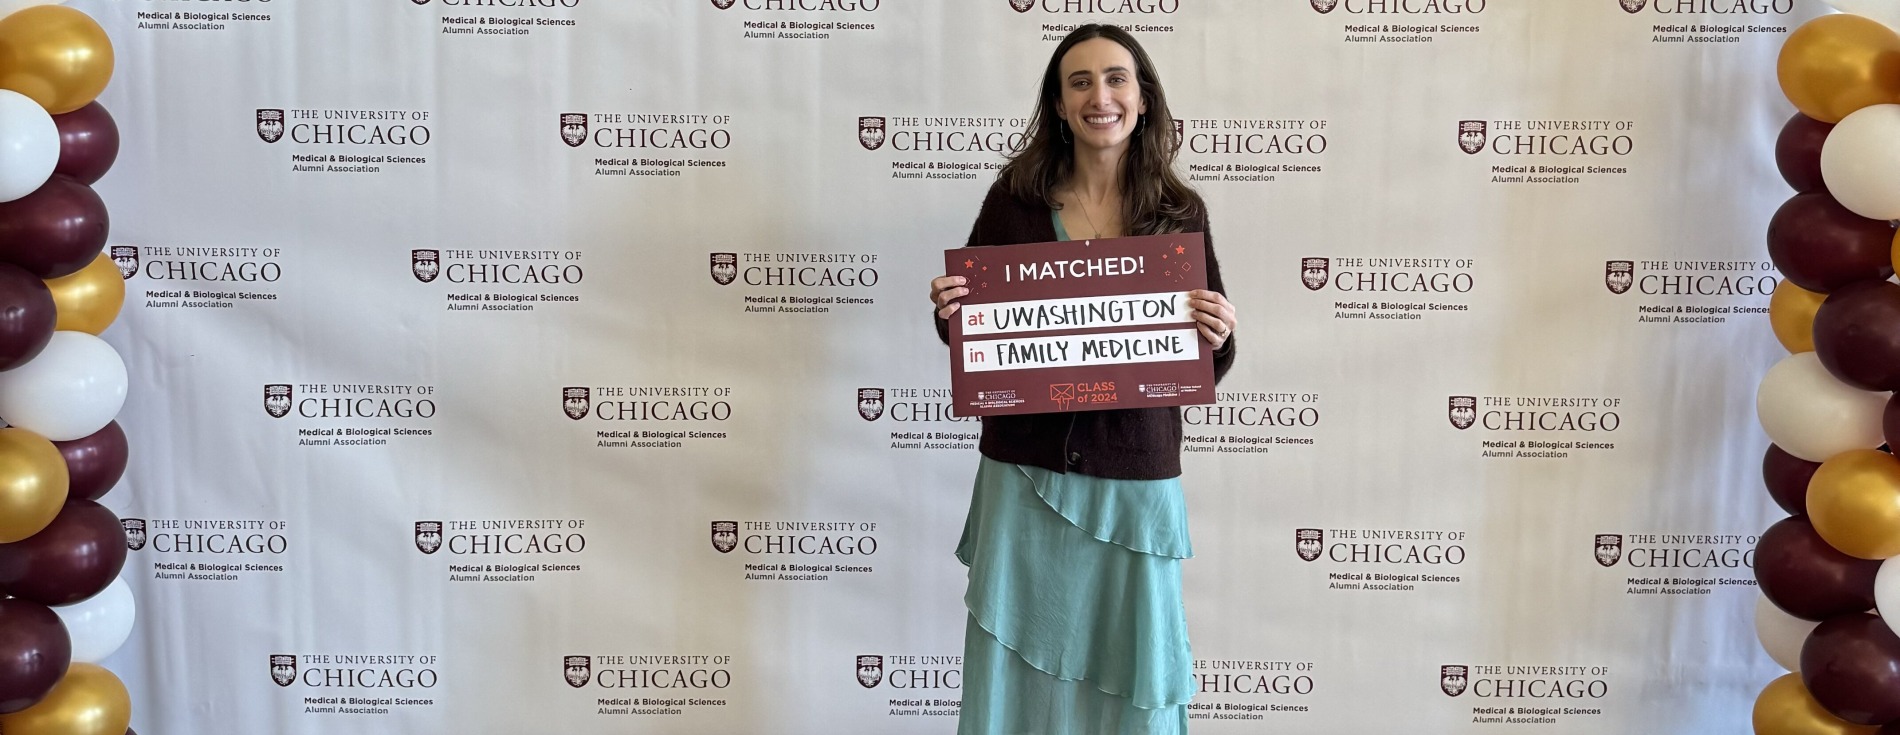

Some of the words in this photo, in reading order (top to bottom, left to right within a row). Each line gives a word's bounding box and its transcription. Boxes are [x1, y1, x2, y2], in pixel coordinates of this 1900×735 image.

[137, 11, 173, 21] Medical
[174, 11, 182, 20] &
[183, 12, 230, 22] Biological
[231, 12, 272, 21] Sciences
[137, 21, 170, 30] Alumni
[171, 21, 225, 31] Association
[743, 20, 779, 30] Medical
[780, 21, 787, 29] &
[788, 21, 834, 31] Biological
[835, 21, 876, 30] Sciences
[1344, 24, 1381, 33] Medical
[1382, 24, 1389, 33] &
[1391, 24, 1438, 34] Biological
[1440, 24, 1480, 33] Sciences
[743, 30, 776, 39] Alumni
[777, 30, 830, 40] Association
[1344, 34, 1377, 43] Alumni
[1378, 34, 1433, 43] Association
[290, 109, 319, 120] THE
[324, 109, 407, 121] UNIVERSITY
[411, 111, 429, 121] OF
[593, 113, 622, 124] THE
[627, 113, 708, 125] UNIVERSITY
[712, 114, 731, 125] OF
[1493, 120, 1522, 131] THE
[1527, 120, 1611, 131] UNIVERSITY
[1615, 120, 1634, 131] OF
[290, 123, 431, 146] CHICAGO
[593, 127, 731, 150] CHICAGO
[1492, 134, 1633, 156] CHICAGO
[292, 153, 328, 163] Medical
[329, 154, 336, 164] &
[338, 155, 385, 165] Biological
[386, 155, 427, 164] Sciences
[594, 157, 630, 167] Medical
[631, 158, 639, 167] &
[640, 158, 686, 168] Biological
[687, 159, 727, 168] Sciences
[291, 163, 325, 172] Alumni
[326, 163, 380, 173] Association
[594, 167, 627, 176] Alumni
[628, 167, 681, 177] Association
[1491, 165, 1528, 174] Medical
[1529, 165, 1537, 174] &
[1538, 165, 1585, 175] Biological
[1586, 165, 1627, 174] Sciences
[1490, 175, 1524, 183] Alumni
[1525, 175, 1580, 184] Association
[445, 249, 474, 259] THE
[478, 249, 560, 260] UNIVERSITY
[564, 250, 582, 261] OF
[1335, 257, 1364, 268] THE
[1369, 258, 1451, 269] UNIVERSITY
[1455, 258, 1474, 269] OF
[445, 263, 584, 285] CHICAGO
[1005, 264, 1011, 282] I
[1019, 256, 1145, 281] MATCHED!
[1334, 271, 1474, 294] CHICAGO
[446, 293, 483, 303] Medical
[483, 293, 491, 302] &
[492, 293, 538, 303] Biological
[540, 293, 580, 302] Sciences
[446, 302, 479, 311] Alumni
[481, 303, 534, 311] Association
[967, 313, 985, 327] at
[993, 294, 1177, 330] UWASHINGTON
[1334, 301, 1370, 311] Medical
[1371, 301, 1379, 311] &
[1380, 302, 1427, 312] Biological
[1428, 302, 1469, 311] Sciences
[1334, 311, 1367, 319] Alumni
[1368, 310, 1422, 320] Association
[969, 348, 985, 363] in
[996, 341, 1069, 366] FAMILY
[1082, 335, 1184, 362] MEDICINE
[298, 383, 328, 394] THE
[332, 384, 413, 395] UNIVERSITY
[416, 385, 434, 395] OF
[1077, 382, 1115, 393] CLASS
[1077, 394, 1089, 403] of
[1091, 392, 1118, 403] 2024
[1483, 396, 1512, 407] THE
[1516, 397, 1599, 408] UNIVERSITY
[1602, 397, 1621, 408] OF
[298, 397, 436, 419] CHICAGO
[1482, 410, 1621, 432] CHICAGO
[298, 427, 335, 437] Medical
[335, 428, 343, 436] &
[345, 427, 392, 437] Biological
[393, 427, 433, 436] Sciences
[298, 438, 331, 446] Alumni
[332, 437, 387, 446] Association
[1482, 440, 1517, 450] Medical
[1518, 440, 1526, 449] &
[1527, 440, 1573, 450] Biological
[1575, 441, 1615, 450] Sciences
[1481, 449, 1514, 458] Alumni
[1515, 449, 1568, 459] Association
[151, 519, 180, 529] THE
[184, 519, 265, 530] UNIVERSITY
[268, 520, 286, 530] OF
[744, 521, 772, 531] THE
[776, 521, 856, 532] UNIVERSITY
[859, 522, 877, 532] OF
[1329, 528, 1358, 539] THE
[1362, 529, 1444, 541] UNIVERSITY
[1447, 531, 1466, 541] OF
[152, 533, 288, 555] CHICAGO
[743, 534, 878, 556] CHICAGO
[1328, 542, 1466, 565] CHICAGO
[154, 562, 188, 572] Medical
[189, 562, 197, 572] &
[198, 564, 243, 574] Biological
[244, 563, 284, 572] Sciences
[744, 563, 779, 573] Medical
[780, 563, 787, 572] &
[788, 563, 833, 573] Biological
[834, 564, 873, 573] Sciences
[154, 571, 186, 580] Alumni
[187, 571, 239, 581] Association
[744, 572, 776, 581] Alumni
[777, 571, 829, 581] Association
[1328, 572, 1364, 582] Medical
[1365, 572, 1372, 582] &
[1374, 574, 1419, 584] Biological
[1421, 574, 1461, 583] Sciences
[1328, 581, 1361, 590] Alumni
[1362, 581, 1415, 591] Association
[596, 655, 625, 665] THE
[629, 655, 709, 665] UNIVERSITY
[713, 655, 731, 665] OF
[1474, 665, 1502, 675] THE
[1506, 665, 1587, 676] UNIVERSITY
[1590, 666, 1608, 676] OF
[596, 669, 731, 689] CHICAGO
[1473, 678, 1608, 699] CHICAGO
[597, 697, 632, 706] Medical
[633, 698, 640, 706] &
[642, 697, 686, 707] Biological
[688, 698, 727, 706] Sciences
[597, 707, 629, 715] Alumni
[630, 707, 682, 715] Association
[1472, 706, 1507, 716] Medical
[1508, 707, 1515, 715] &
[1517, 706, 1562, 716] Biological
[1563, 707, 1602, 715] Sciences
[1472, 715, 1504, 724] Alumni
[1505, 716, 1556, 724] Association
